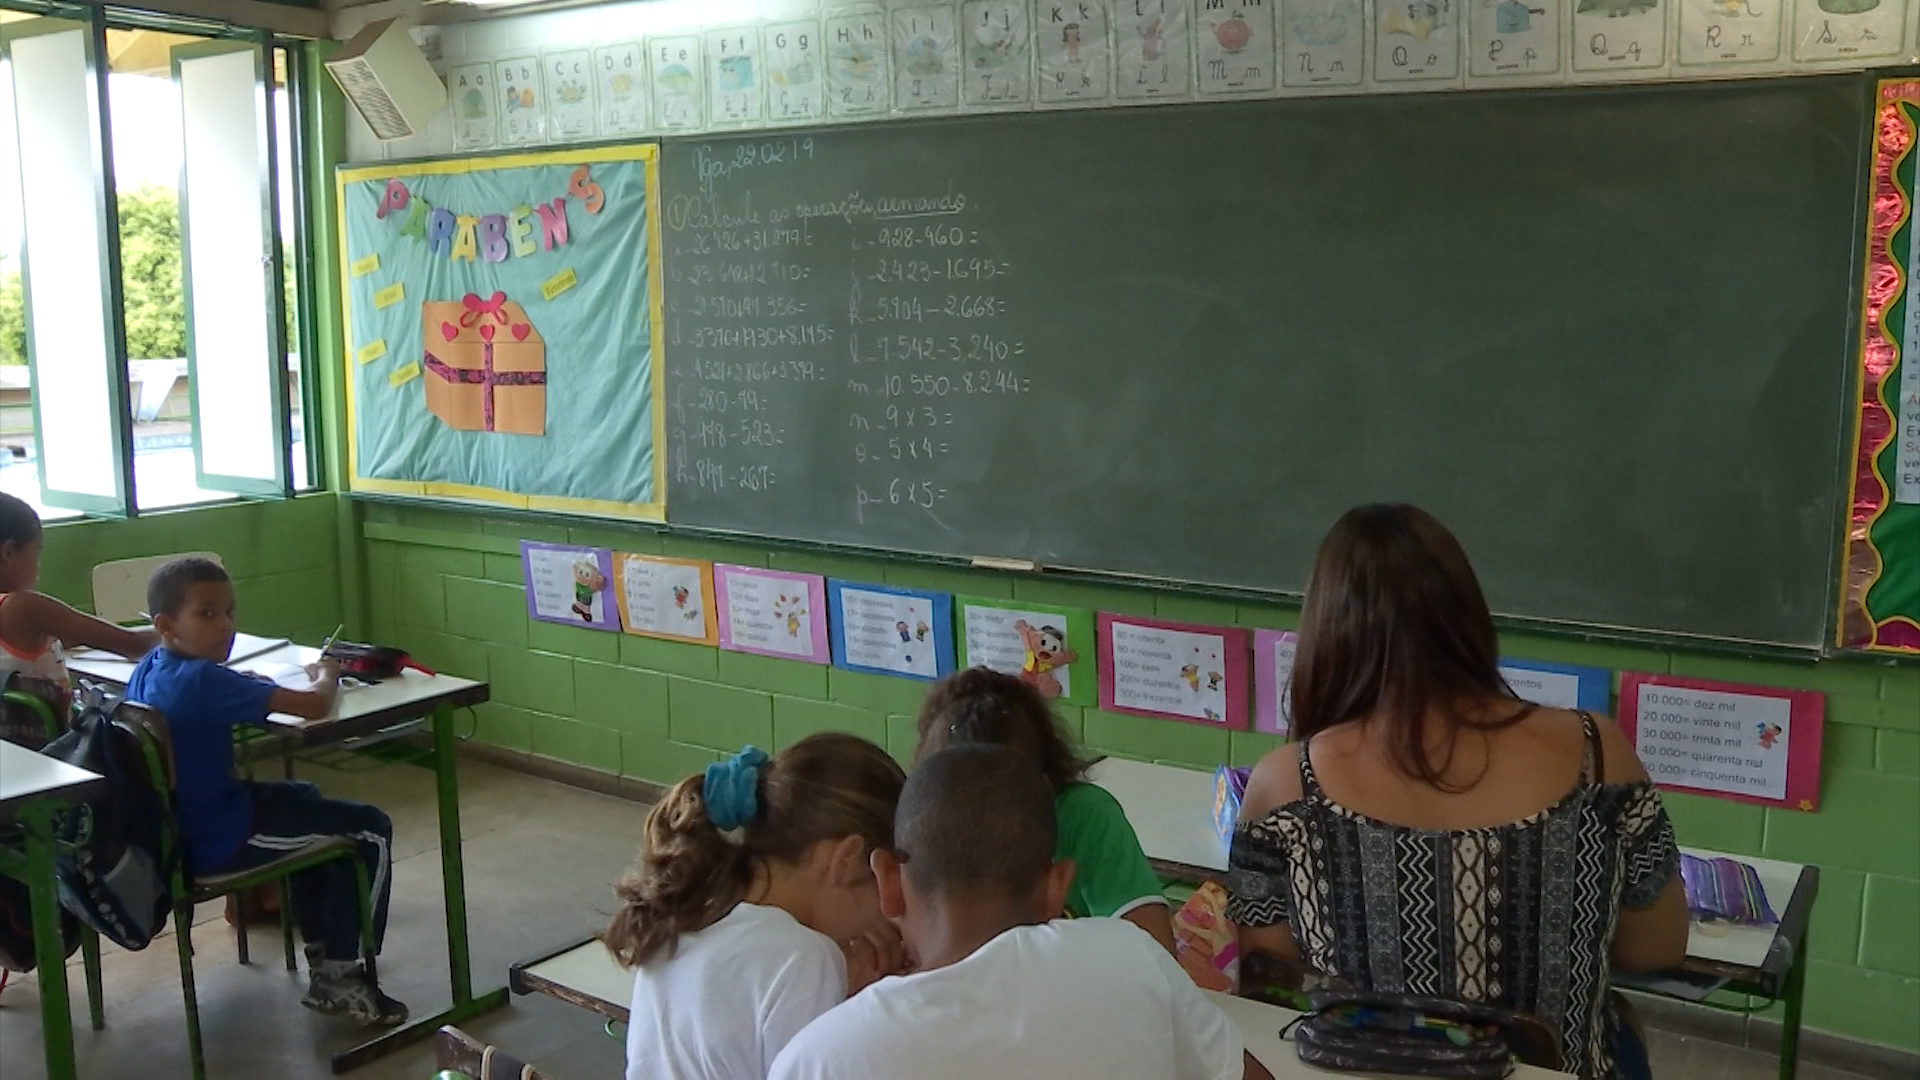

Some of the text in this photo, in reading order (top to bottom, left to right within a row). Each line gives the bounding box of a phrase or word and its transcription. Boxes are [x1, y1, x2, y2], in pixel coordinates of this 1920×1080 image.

[1052, 7, 1063, 23] K
[776, 32, 808, 50] G g
[837, 24, 873, 43] H h
[1704, 25, 1722, 48] R
[605, 52, 632, 70] D d
[661, 47, 687, 62] E e
[505, 66, 529, 82] B b
[556, 61, 581, 76] C c
[459, 76, 468, 87] A
[1646, 693, 1659, 704] 10
[1693, 700, 1716, 710] dez
[1718, 702, 1736, 712] mil
[1643, 711, 1658, 722] 20
[1694, 718, 1720, 728] vinte
[1724, 720, 1742, 730] mil
[1643, 728, 1657, 738] 30
[1692, 734, 1721, 746] trinta
[1724, 738, 1742, 748] mil
[1642, 746, 1656, 756] 40
[1692, 752, 1742, 766] quarenta
[1745, 758, 1764, 768] mil
[1750, 776, 1767, 787] mil
